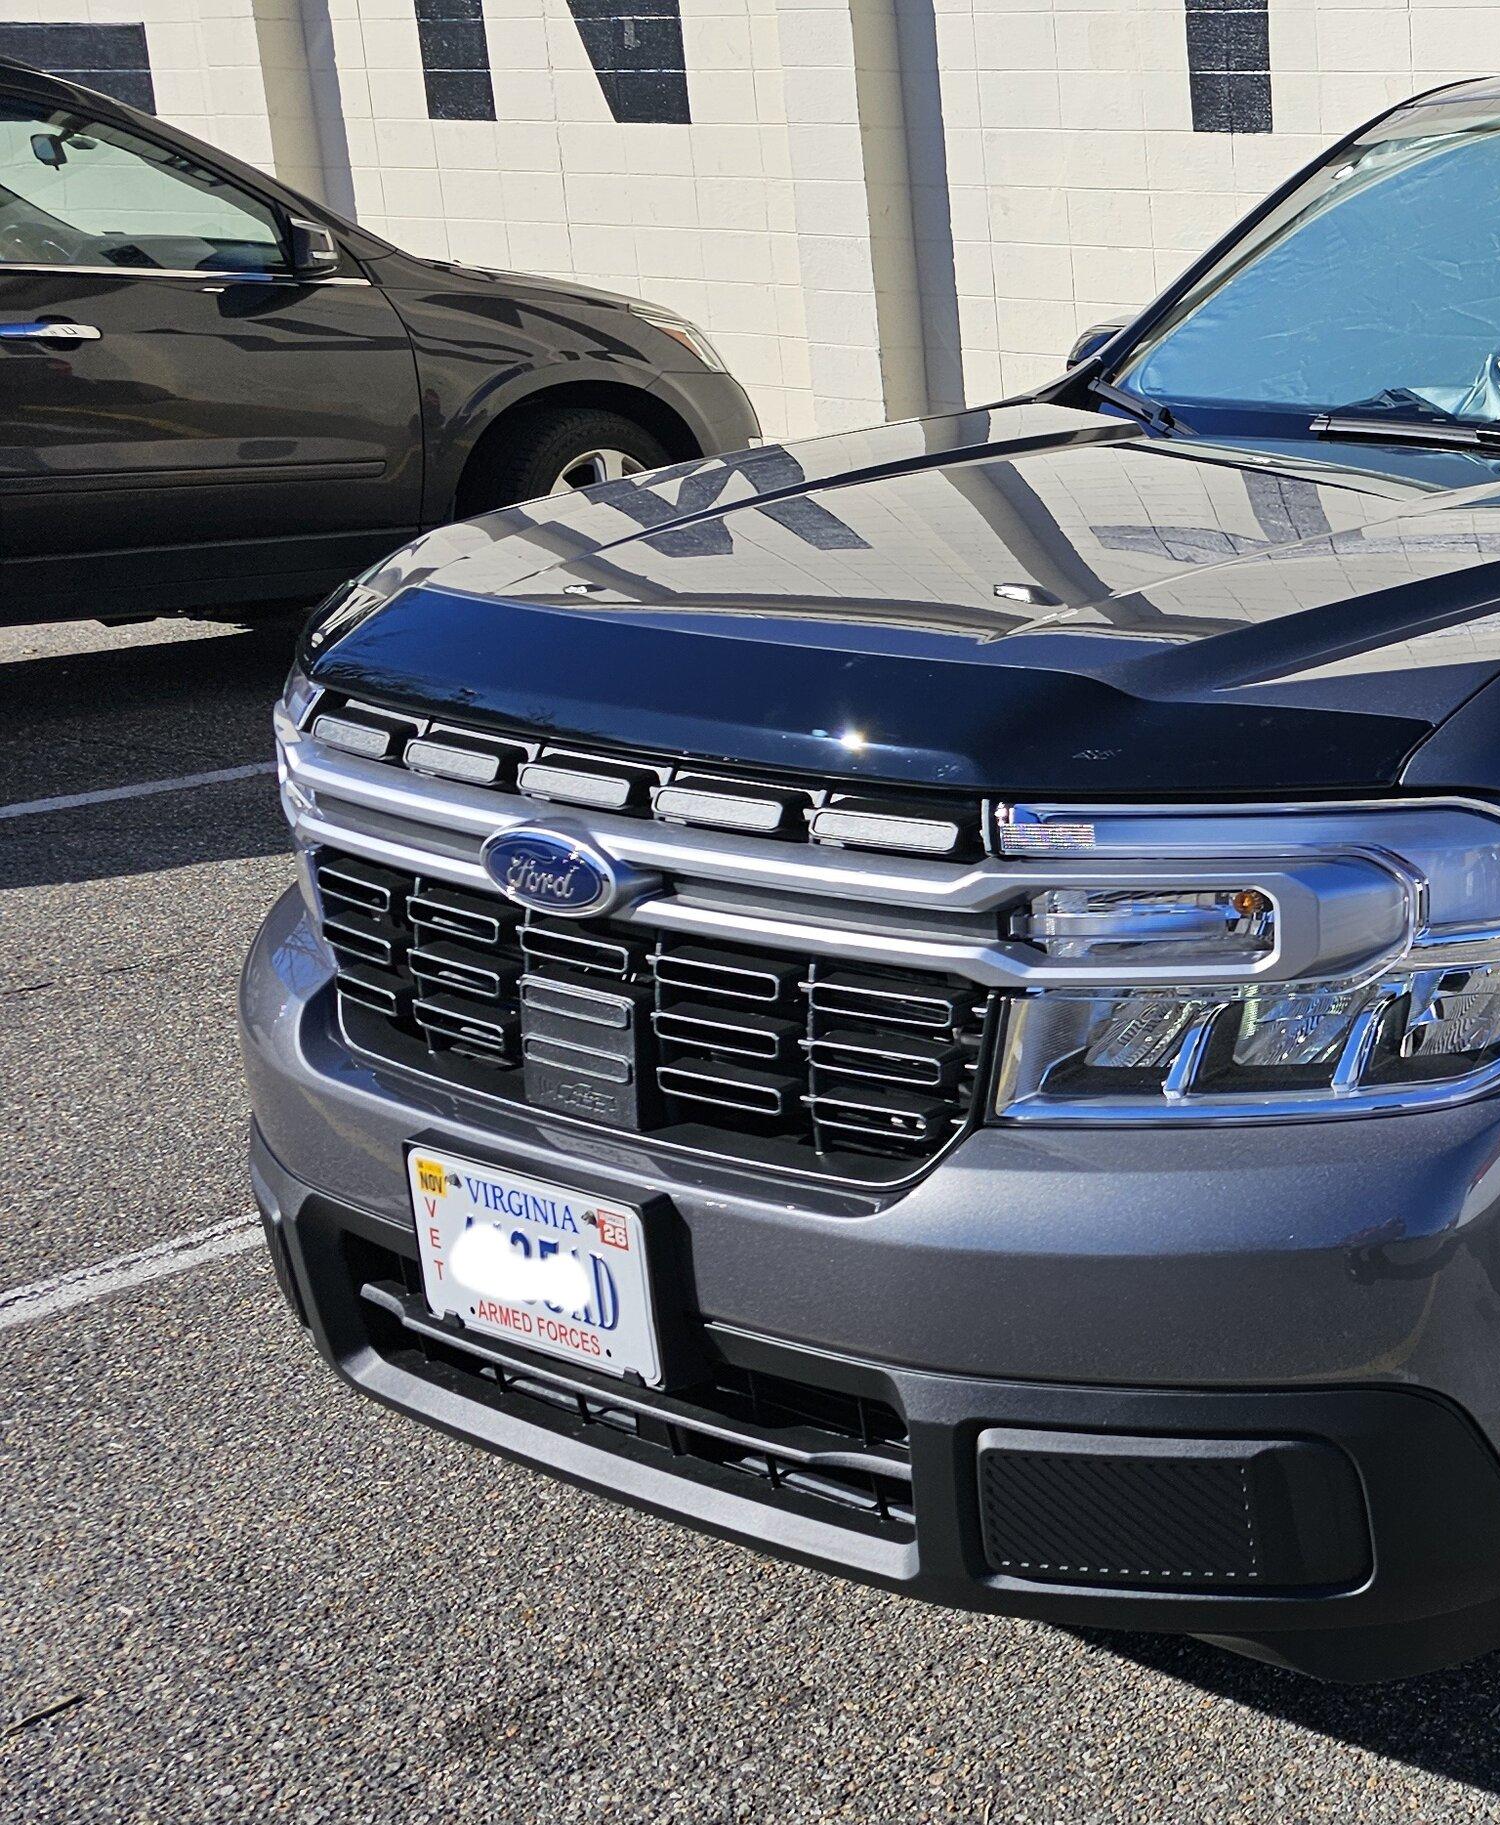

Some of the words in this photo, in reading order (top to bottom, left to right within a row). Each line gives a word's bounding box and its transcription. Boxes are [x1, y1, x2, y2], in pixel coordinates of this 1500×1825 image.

[507, 848, 580, 898] Ford
[419, 1171, 442, 1193] NOV
[465, 1177, 579, 1234] VIRGINIA
[603, 1223, 627, 1247] 26
[478, 1300, 532, 1333] ARMED
[538, 1318, 601, 1356] FORCES
